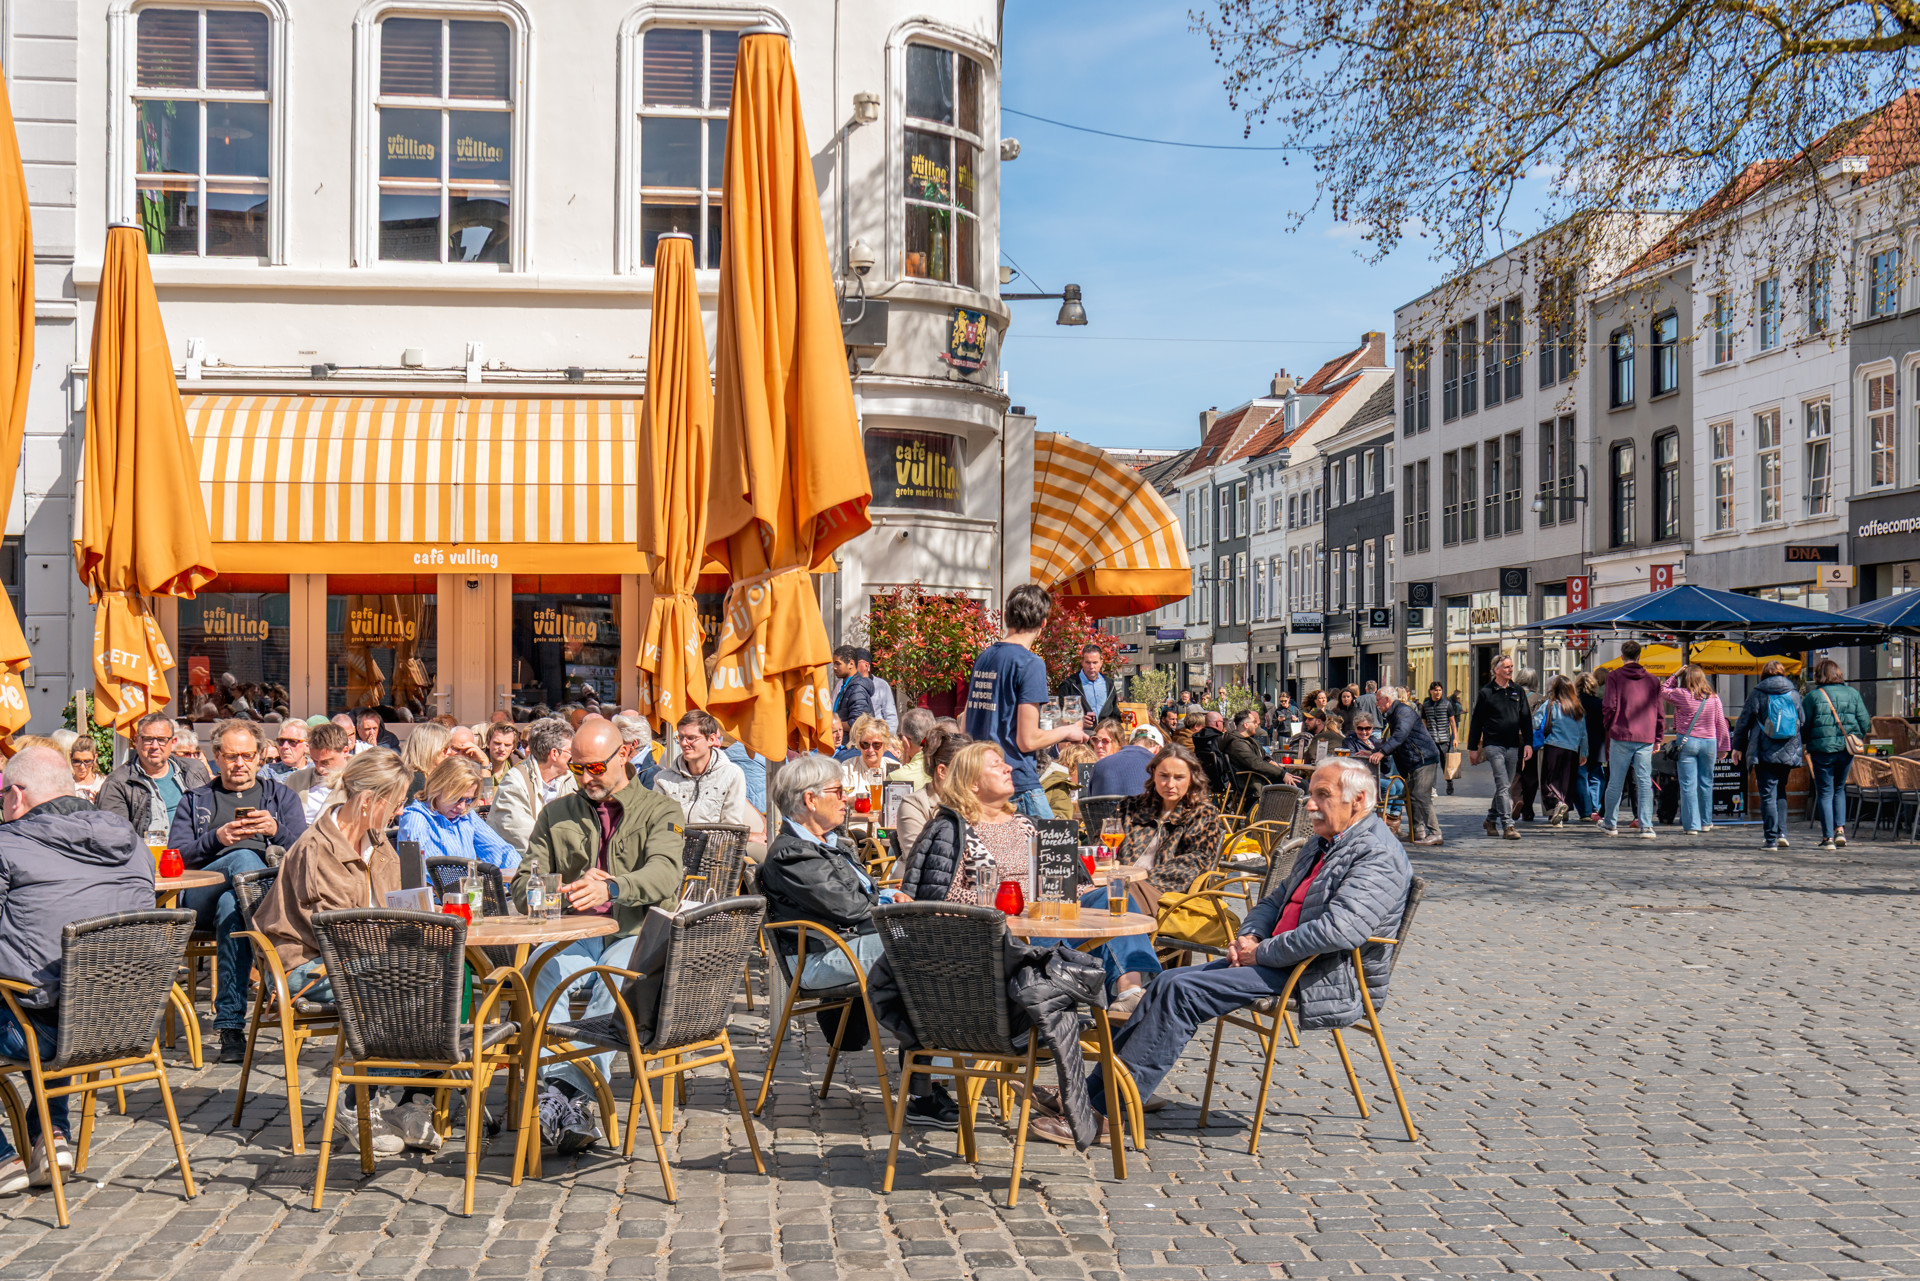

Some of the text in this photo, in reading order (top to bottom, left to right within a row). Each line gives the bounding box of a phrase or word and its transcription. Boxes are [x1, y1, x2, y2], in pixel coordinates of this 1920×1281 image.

[388, 139, 434, 160] vulling
[457, 141, 503, 162] vulling
[912, 159, 946, 183] vulling
[896, 440, 926, 461] café
[896, 451, 961, 500] vulling
[896, 487, 914, 498] grote
[916, 488, 934, 497] markt
[935, 489, 942, 498] 16
[1859, 516, 1920, 537] coffeecompa
[414, 548, 498, 568] café vulling
[1789, 548, 1820, 560] DNA
[203, 606, 226, 618] café
[351, 607, 373, 619] café
[533, 608, 555, 619] café
[1471, 608, 1499, 624] OMODA
[204, 613, 269, 640] vulling
[351, 613, 415, 640] vulling
[534, 614, 597, 641] vulling
[1704, 664, 1755, 672] coffeecompany
[1038, 828, 1070, 840] Today's
